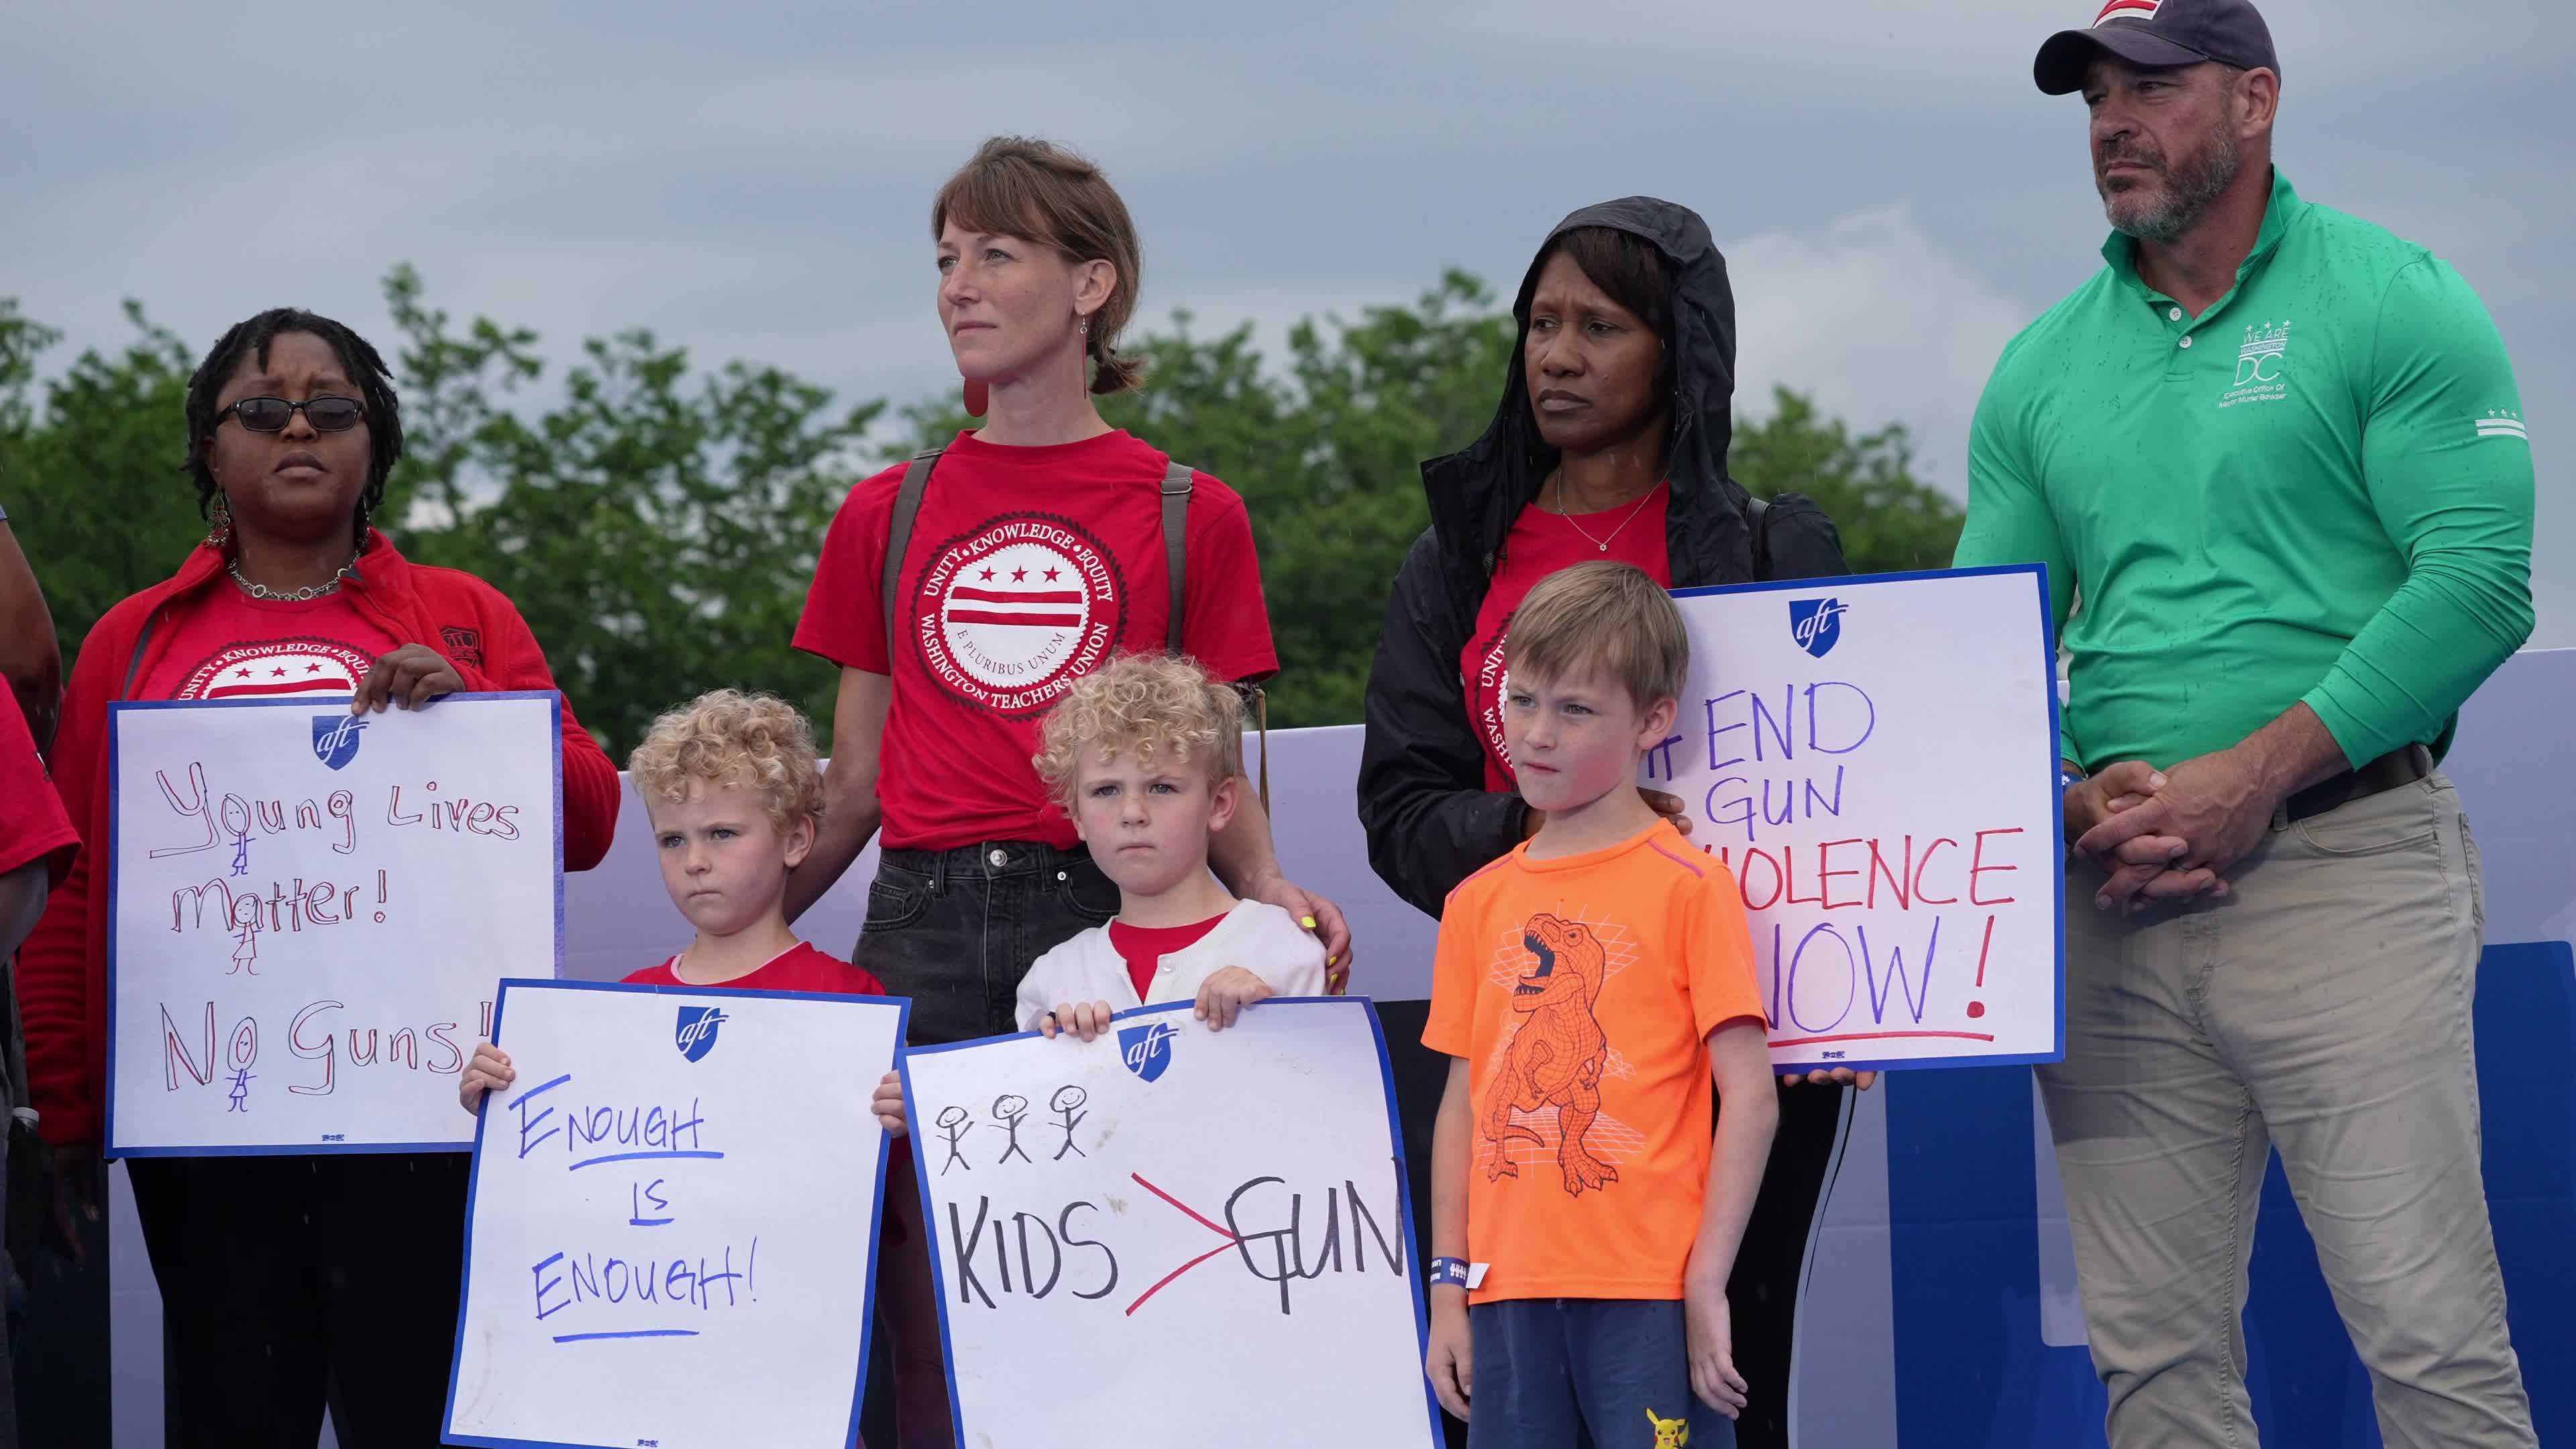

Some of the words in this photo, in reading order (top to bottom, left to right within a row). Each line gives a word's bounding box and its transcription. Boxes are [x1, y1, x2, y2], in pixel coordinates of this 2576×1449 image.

[2233, 352, 2283, 386] DC
[2243, 331, 2261, 343] WE
[2263, 327, 2290, 340] ARE
[924, 549, 965, 596] UNITY
[969, 523, 1075, 555] KNOWLEDGE
[1077, 548, 1112, 601] EQUITY
[178, 663, 217, 700] UNITY
[221, 643, 332, 661] KNOWLEDGE
[335, 650, 371, 679] EQUI
[921, 613, 988, 701] WASHINGTON
[1071, 622, 1109, 676] UNION
[957, 629, 968, 639] E
[963, 641, 1024, 676] PLURIBUS
[1028, 633, 1067, 669] UNUM
[1481, 633, 1508, 688] UNIT
[149, 762, 355, 859] Young
[387, 782, 520, 841] Lives
[1705, 765, 1843, 841] GUN
[1704, 828, 2023, 910] OLENCE
[633, 1179, 668, 1220] IS
[532, 1236, 757, 1320] ENOUGH!
[949, 1195, 1118, 1309] KIDS
